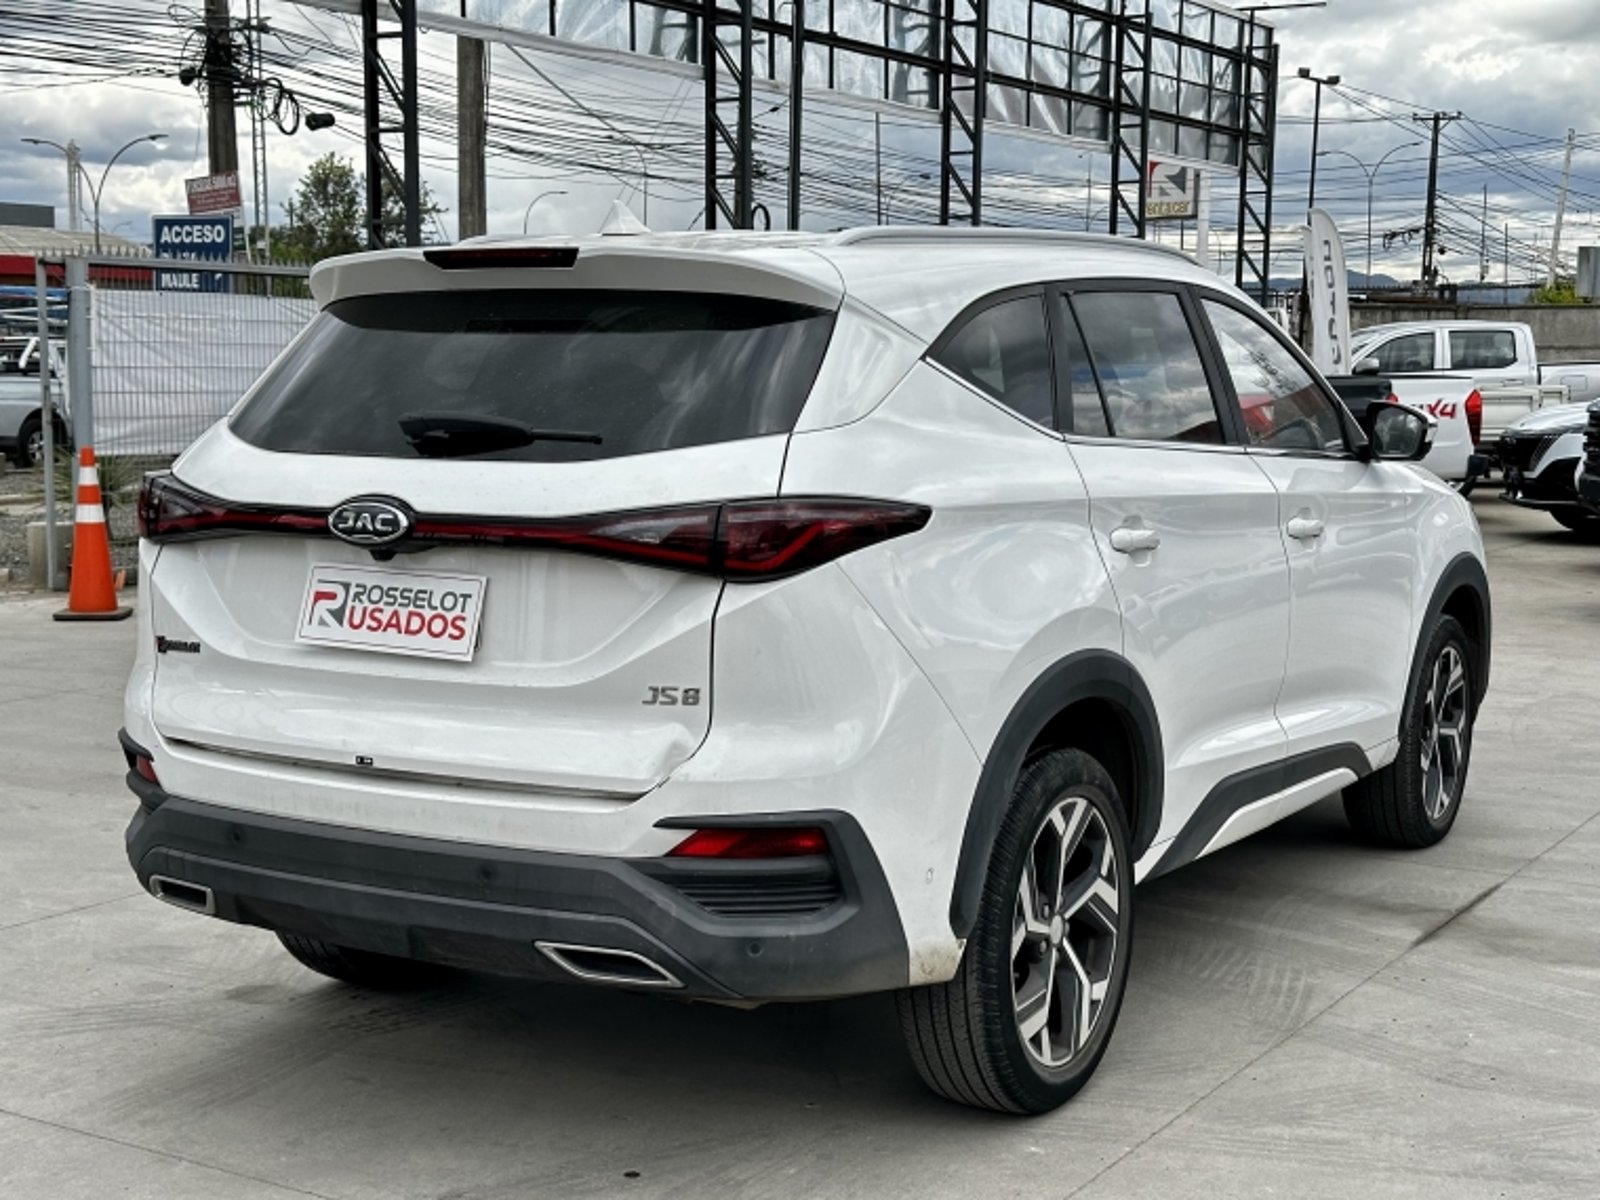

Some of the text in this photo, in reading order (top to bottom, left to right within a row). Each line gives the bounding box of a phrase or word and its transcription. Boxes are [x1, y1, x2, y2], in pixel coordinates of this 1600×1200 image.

[160, 225, 225, 244] ACCESO
[162, 272, 200, 288] MAULE
[338, 511, 395, 532] JAC
[351, 583, 472, 613] ROSSELOT
[347, 605, 467, 641] USADOS
